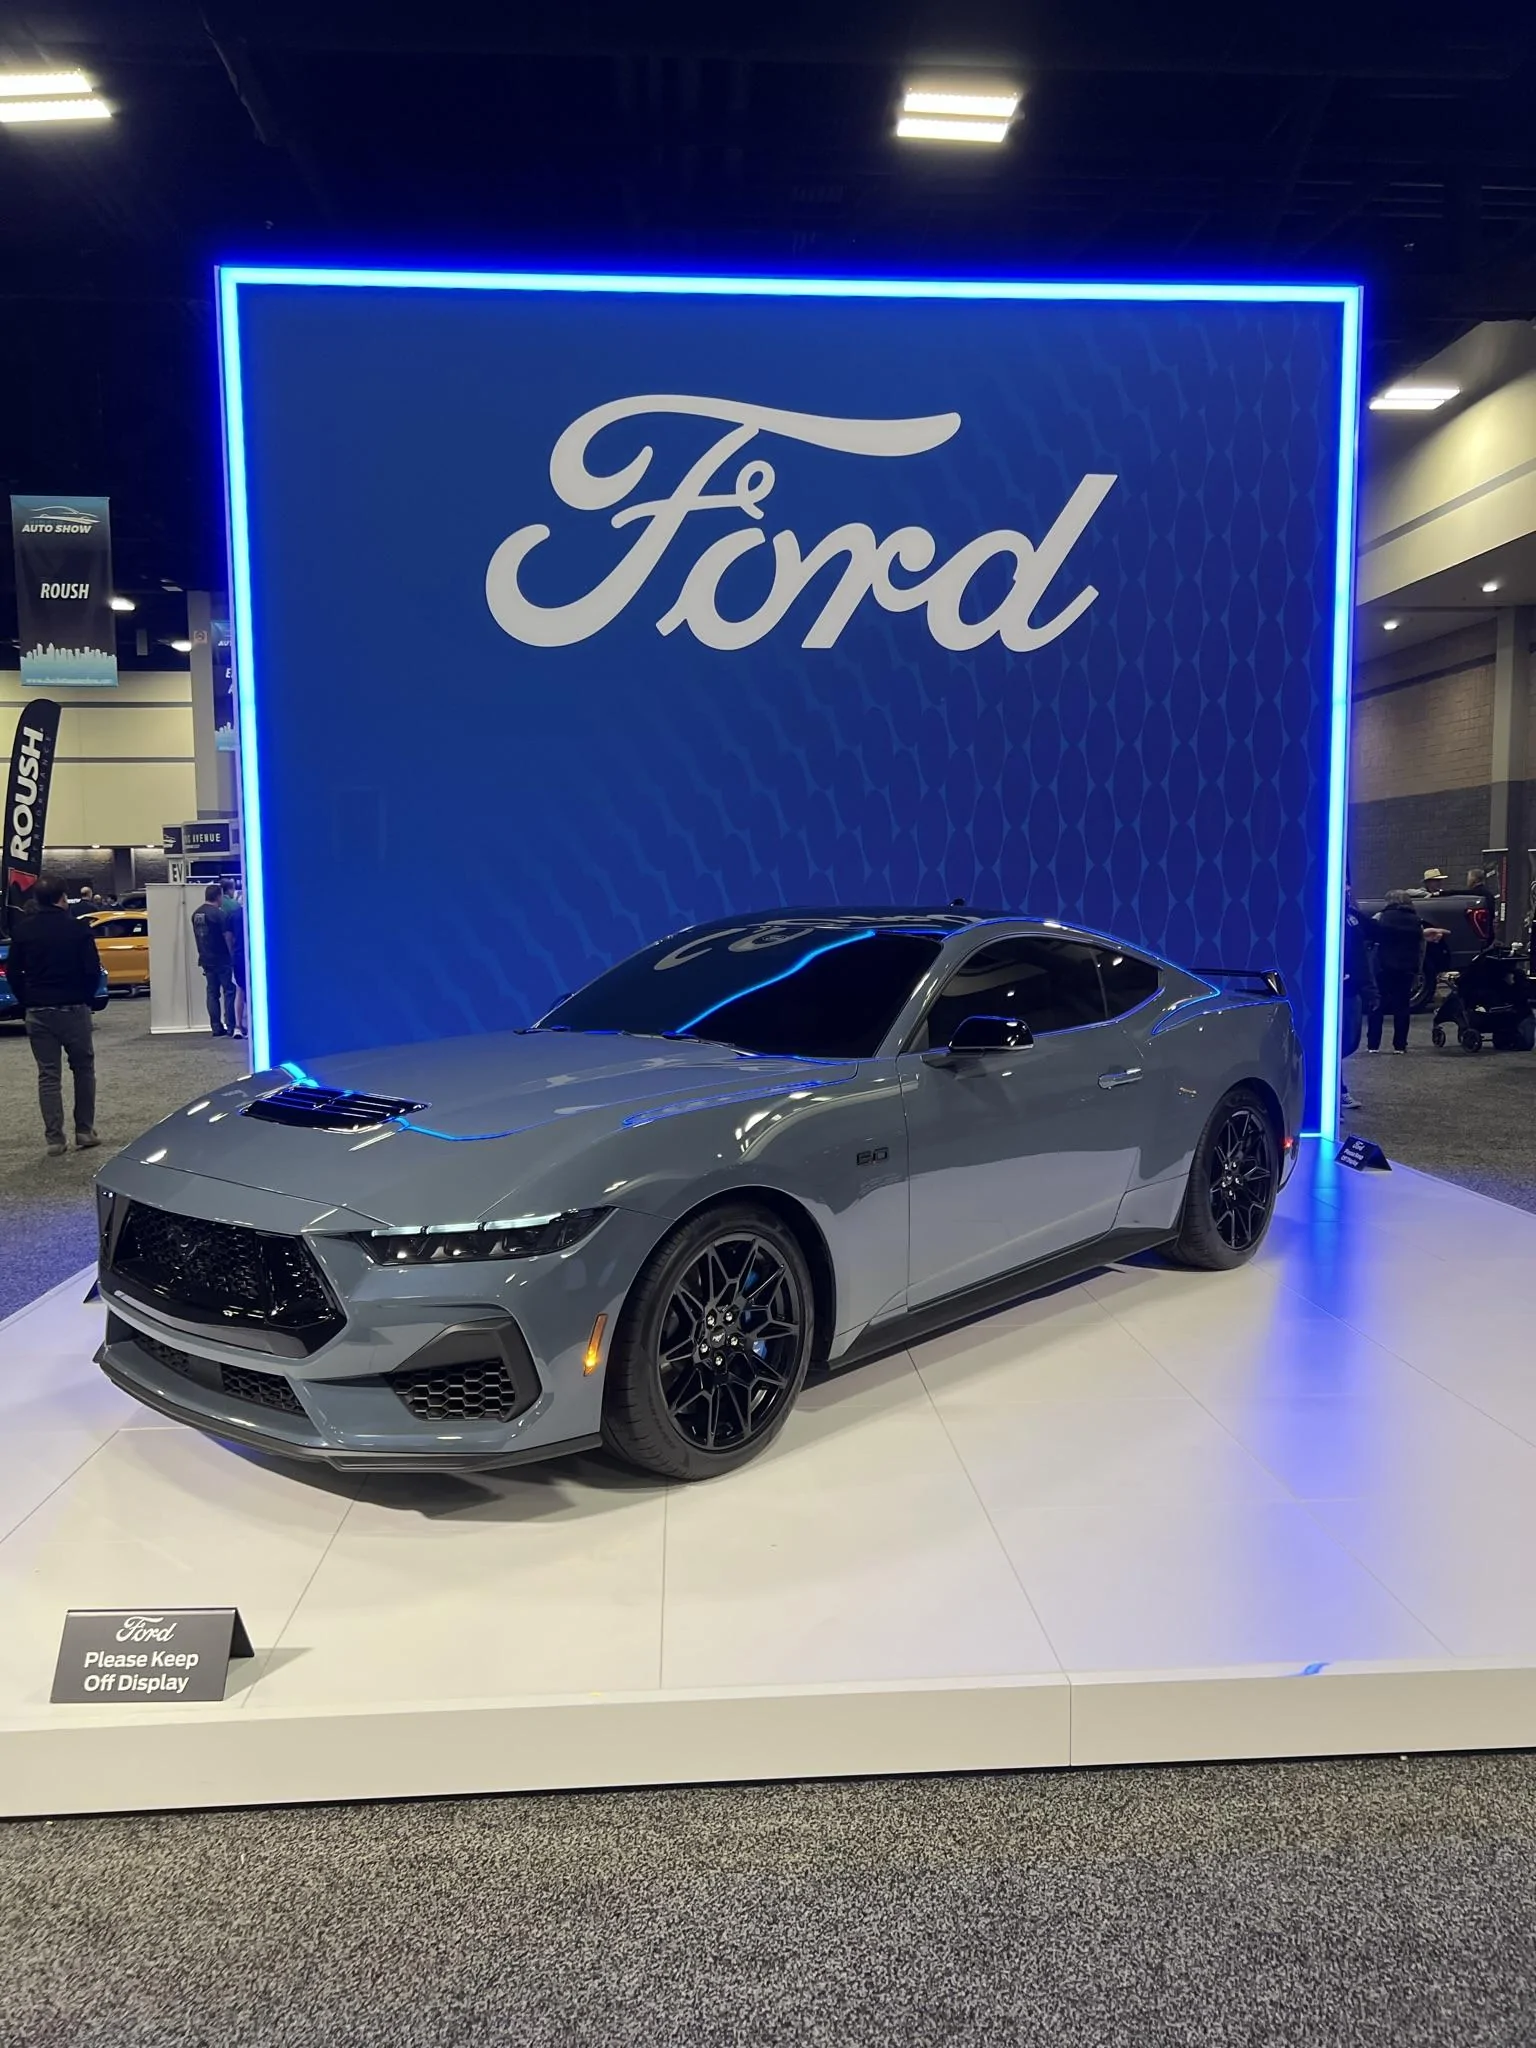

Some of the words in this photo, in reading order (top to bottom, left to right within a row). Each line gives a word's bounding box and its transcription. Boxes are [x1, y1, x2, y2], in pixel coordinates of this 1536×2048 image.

[22, 524, 53, 533] AUTO
[54, 524, 92, 533] SHOW
[485, 394, 1118, 652] Ford
[40, 583, 90, 599] ROUSH
[10, 726, 44, 861] ROUSH
[115, 1615, 178, 1642] Ford
[84, 1651, 148, 1668] Please
[150, 1650, 199, 1670] Keep
[83, 1674, 116, 1692] Off
[117, 1674, 190, 1693] Display
